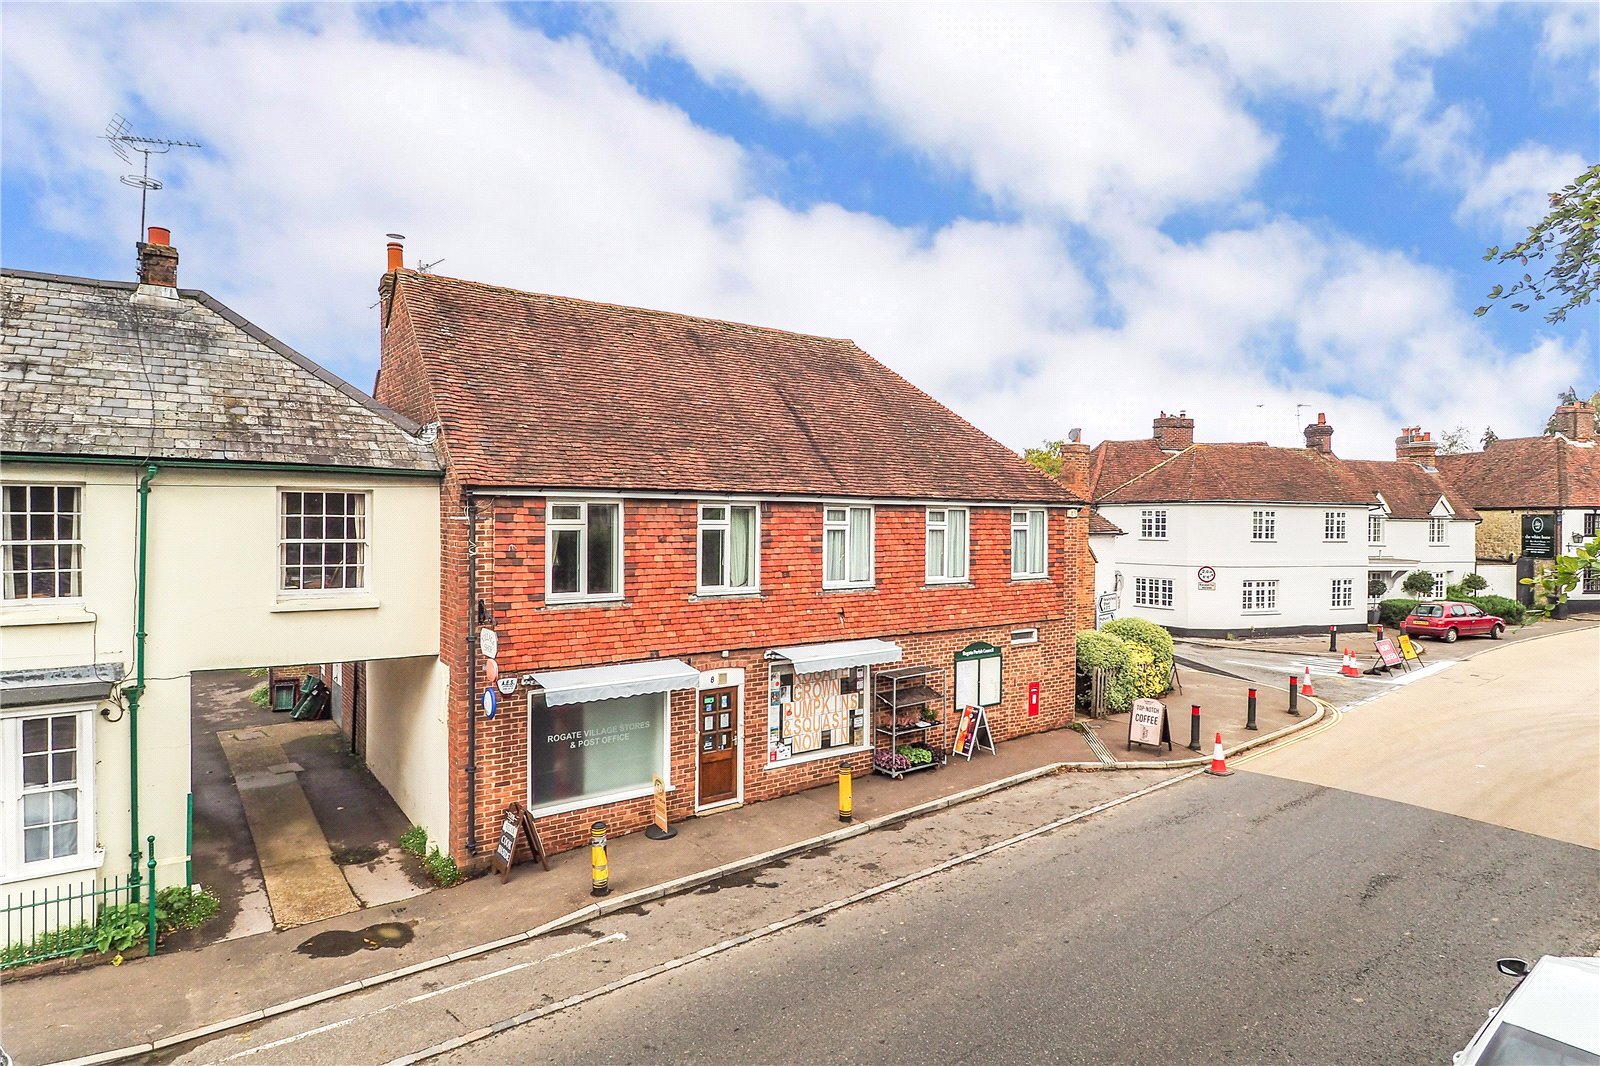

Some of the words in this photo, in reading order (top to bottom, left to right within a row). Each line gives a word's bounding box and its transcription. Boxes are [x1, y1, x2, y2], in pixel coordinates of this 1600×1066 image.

[794, 679, 840, 701] GROWN
[784, 694, 857, 718] PUMPKINS
[1137, 705, 1159, 713] TOP-NOTCH
[1135, 714, 1158, 725] COFFEE
[547, 731, 582, 743] ROGATE
[584, 725, 617, 737] VILLAGE
[620, 721, 650, 732] STORES
[578, 737, 600, 747] POST
[602, 733, 630, 744] OFFICE
[794, 732, 820, 752] NOW
[833, 729, 848, 745] IN
